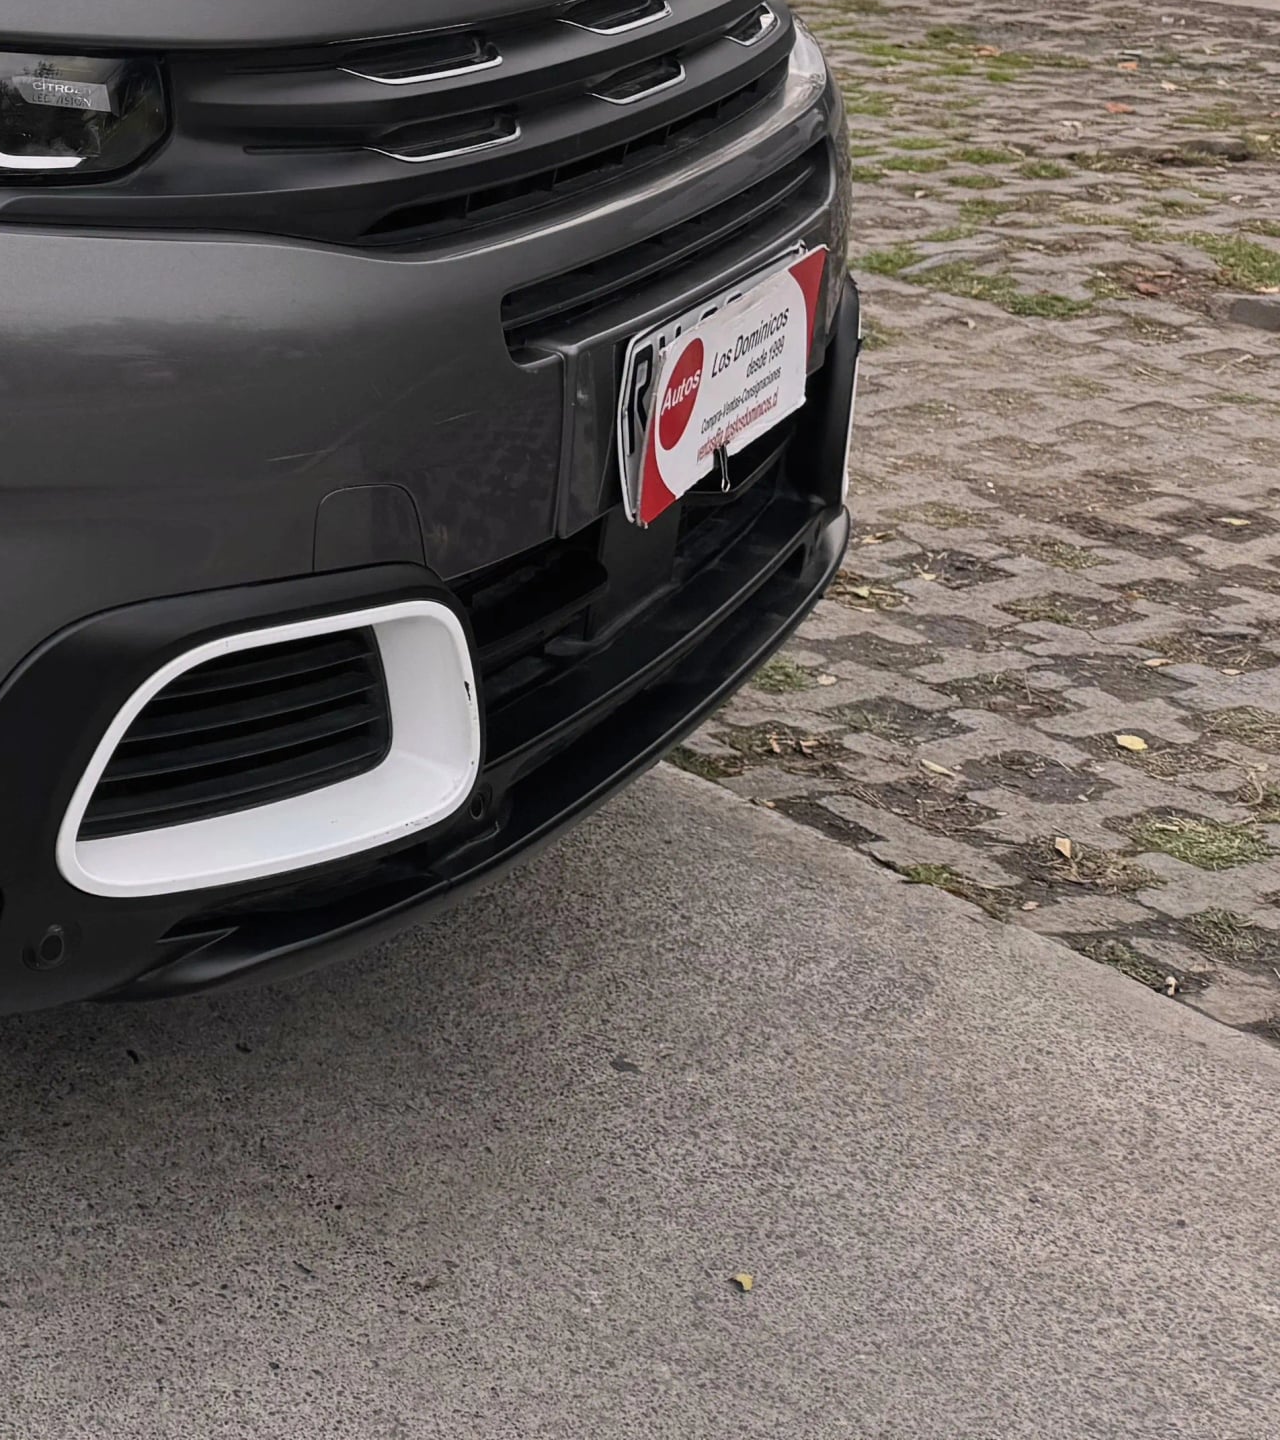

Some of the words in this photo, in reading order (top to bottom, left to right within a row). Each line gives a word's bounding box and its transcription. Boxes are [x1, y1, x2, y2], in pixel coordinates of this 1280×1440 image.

[711, 347, 733, 378] Los
[733, 308, 789, 362] Dominicos
[660, 368, 702, 417] Autos
